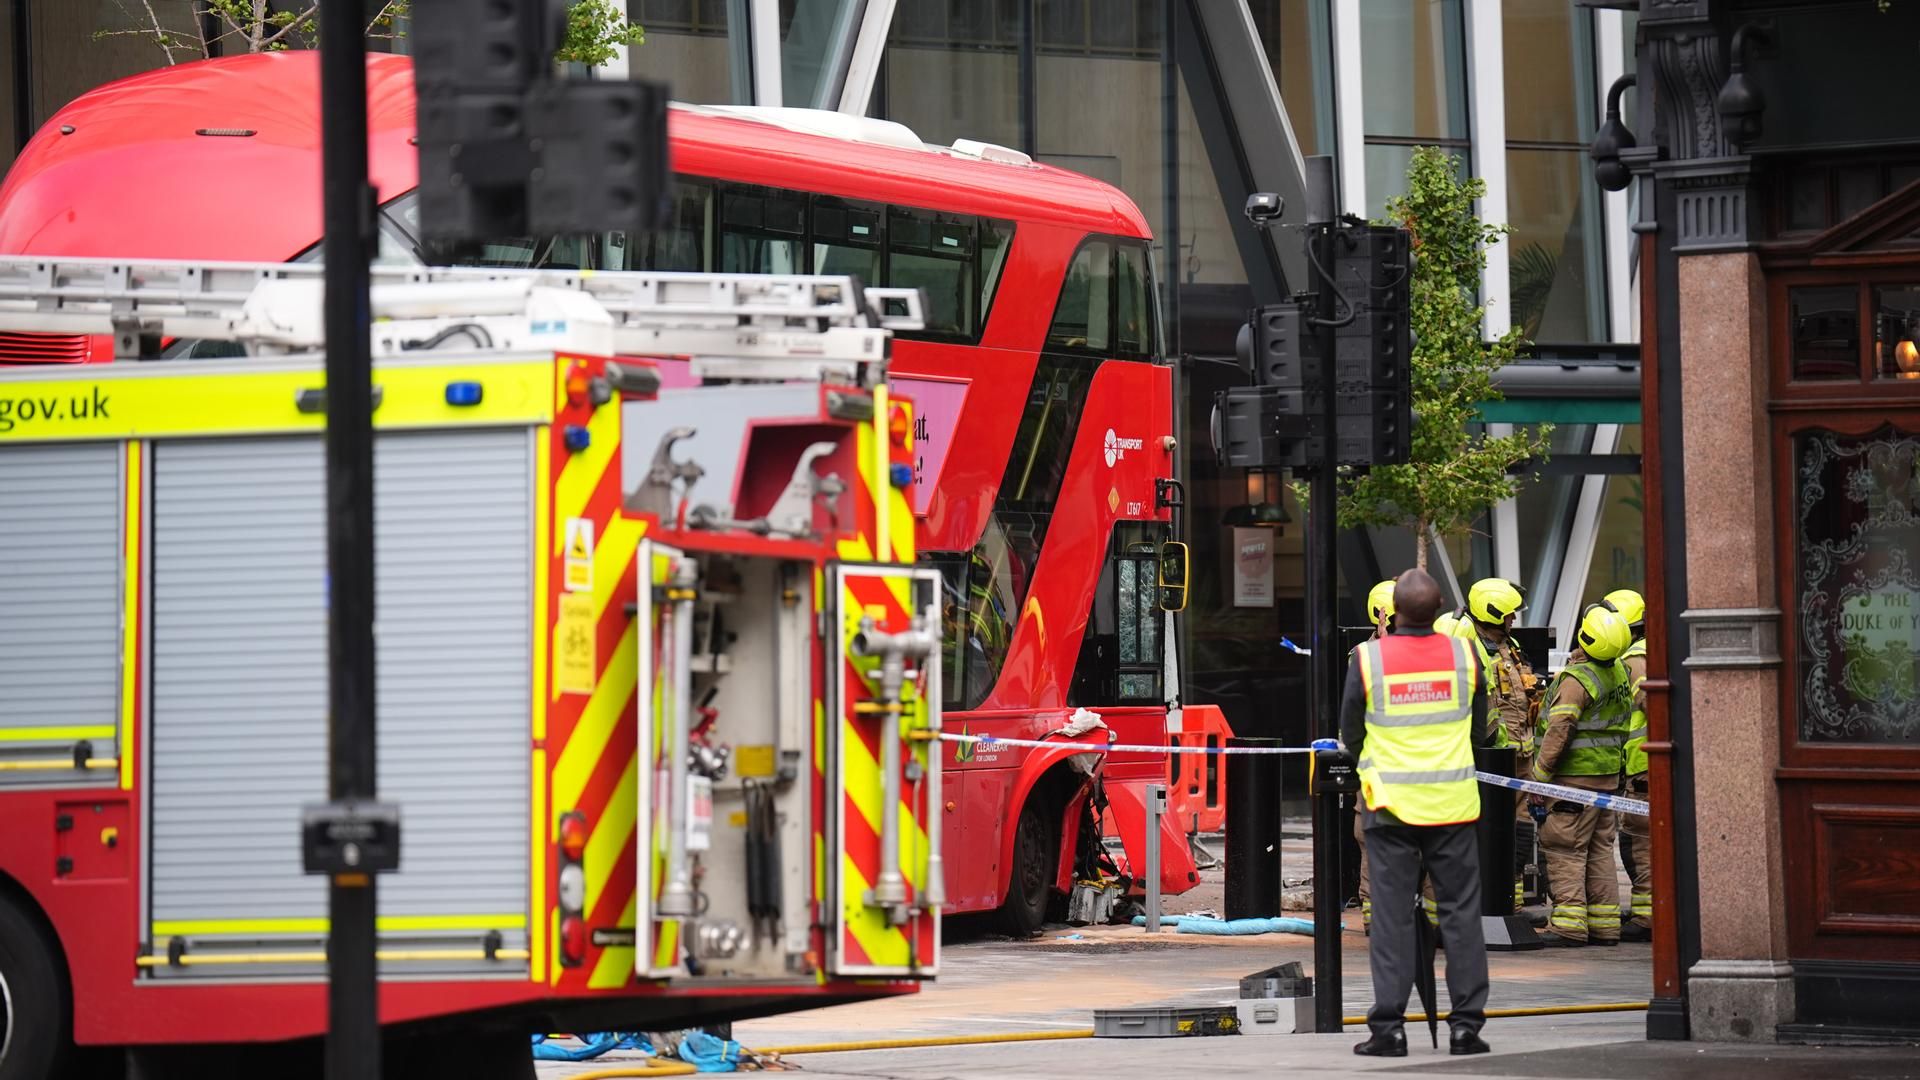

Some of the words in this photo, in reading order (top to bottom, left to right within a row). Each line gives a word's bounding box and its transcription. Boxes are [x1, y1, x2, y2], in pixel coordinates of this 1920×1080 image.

[0, 386, 109, 432] gov.uk
[1116, 437, 1143, 450] TRANSPORT
[1117, 449, 1125, 460] UK
[1127, 502, 1141, 516] LT617
[1881, 592, 1910, 607] THE
[1844, 613, 1883, 631] DUKE
[1889, 615, 1904, 630] OF
[1407, 682, 1433, 693] FIRE
[1607, 681, 1630, 706] FIRE
[1391, 690, 1450, 703] MARSHAL
